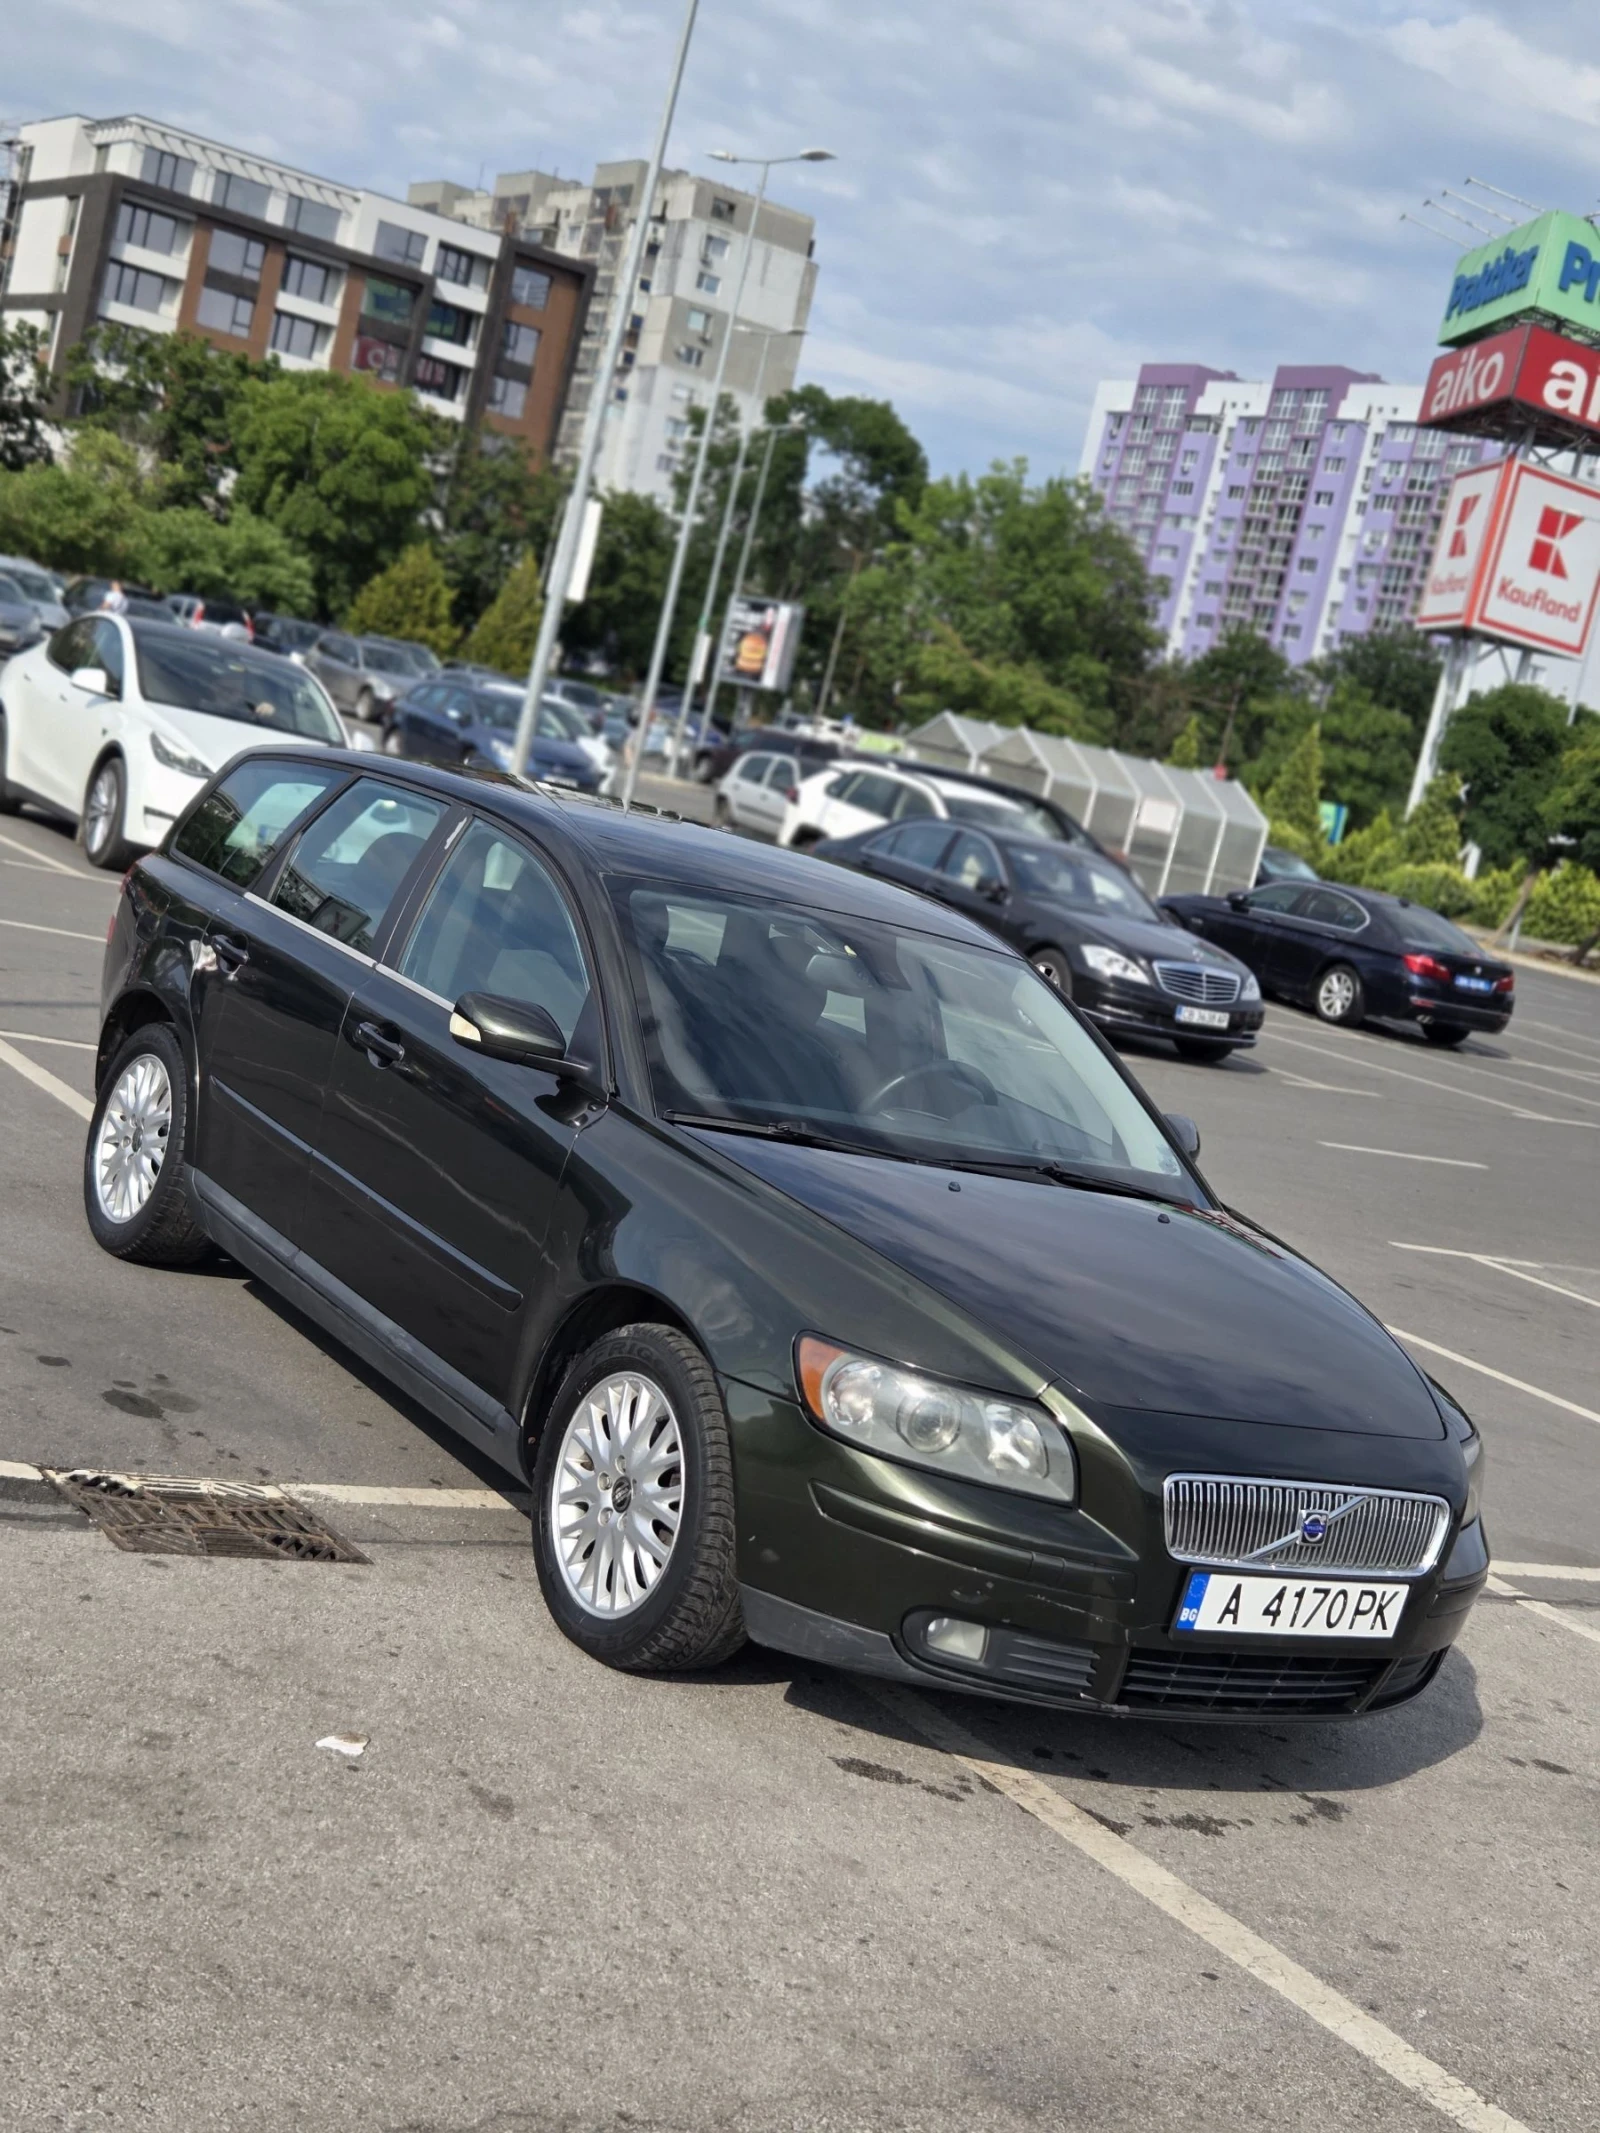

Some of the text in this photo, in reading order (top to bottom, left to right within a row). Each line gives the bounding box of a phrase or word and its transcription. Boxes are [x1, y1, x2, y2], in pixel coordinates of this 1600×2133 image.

[1430, 347, 1505, 416] aiko
[1497, 577, 1582, 623] Kaufland
[1180, 1607, 1197, 1621] BG
[1217, 1583, 1242, 1624] A
